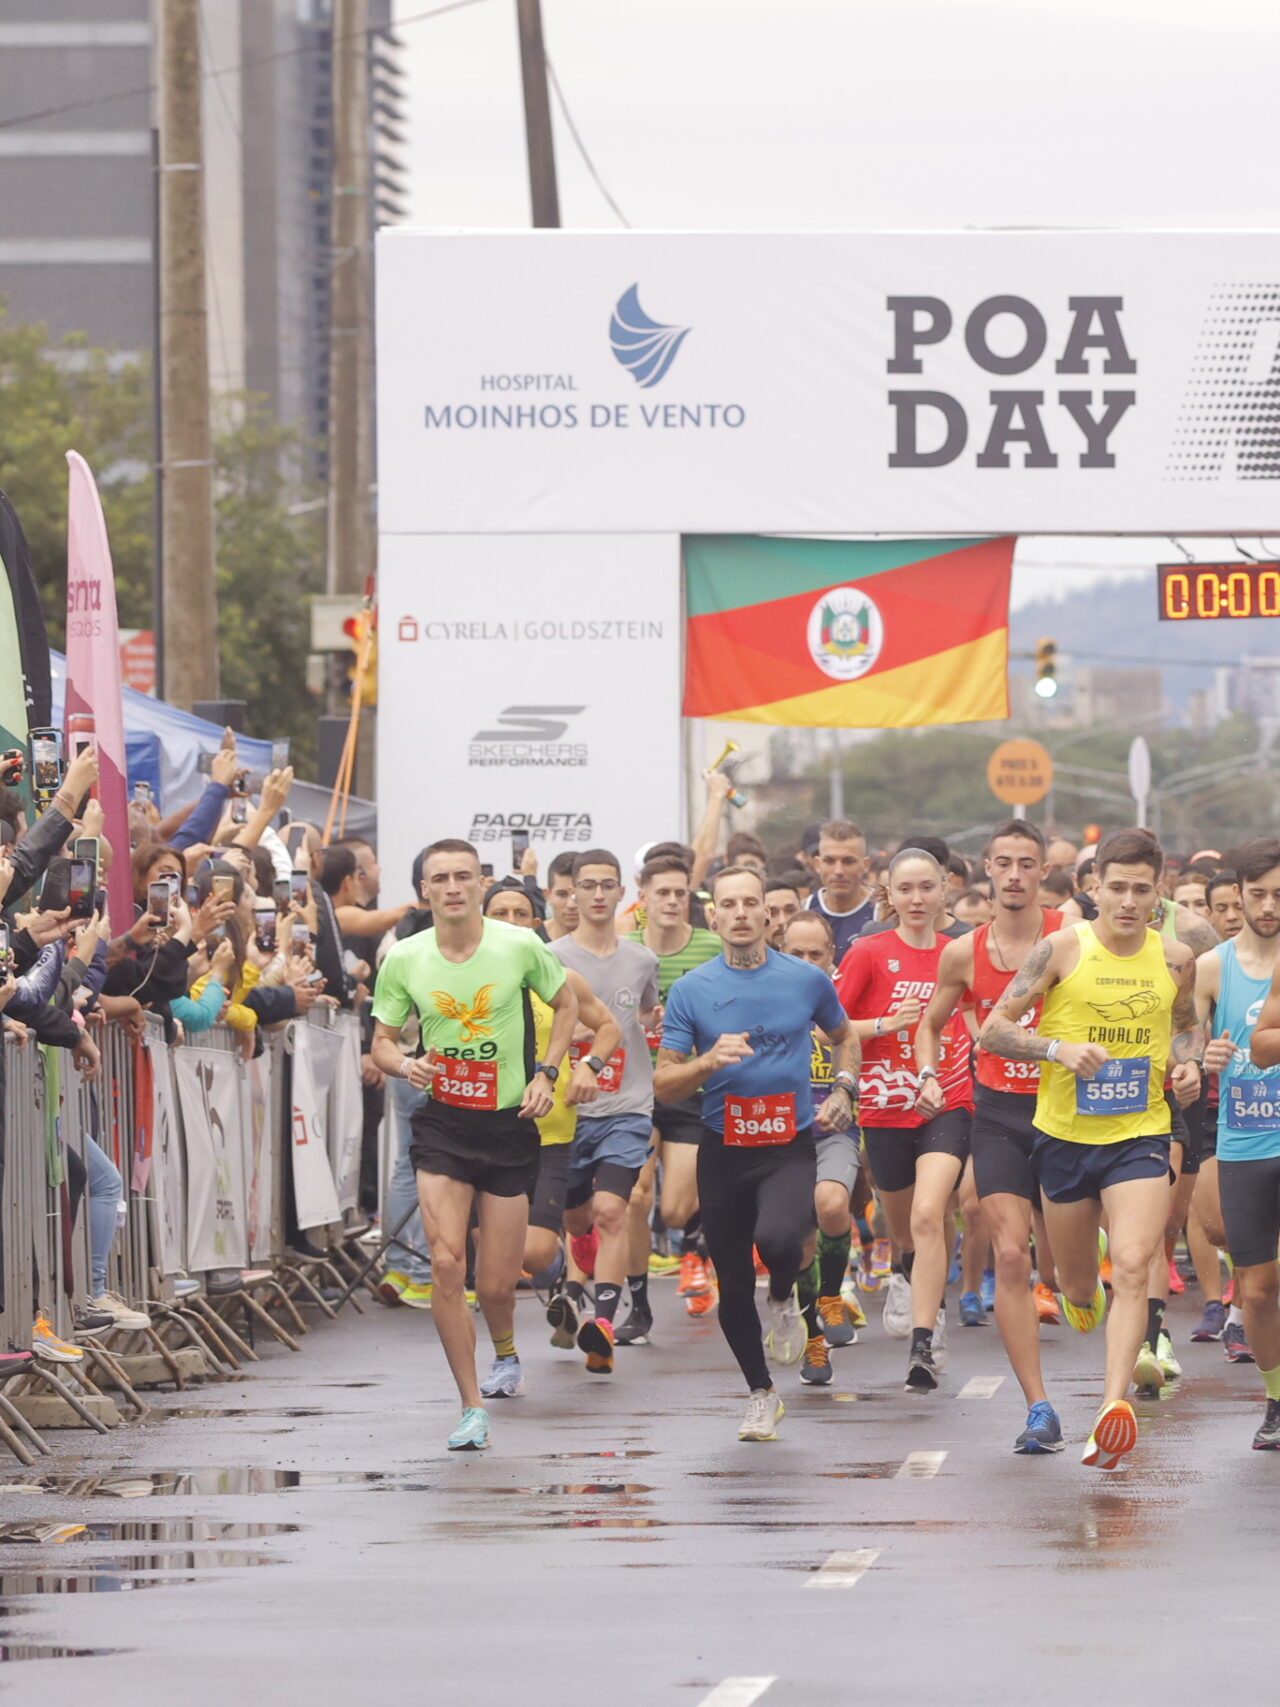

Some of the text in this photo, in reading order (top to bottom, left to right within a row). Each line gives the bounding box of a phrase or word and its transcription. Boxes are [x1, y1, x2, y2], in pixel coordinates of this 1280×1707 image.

[885, 293, 1138, 377] POA
[481, 374, 578, 391] HOSPITAL
[424, 403, 747, 429] MOINHOS DE VENTO
[887, 389, 1137, 469] DAY
[424, 620, 664, 640] CYRELA GOLDSZTEIN
[468, 743, 589, 758] SKECHERS
[468, 757, 588, 767] PERFORMANCE
[471, 812, 593, 828] PAQUETA
[467, 828, 593, 842] ESPRTES
[1088, 1026, 1151, 1045] CAVALOS
[438, 1076, 490, 1098] 3282
[1086, 1080, 1140, 1101] 5555
[733, 1116, 787, 1136] 3946
